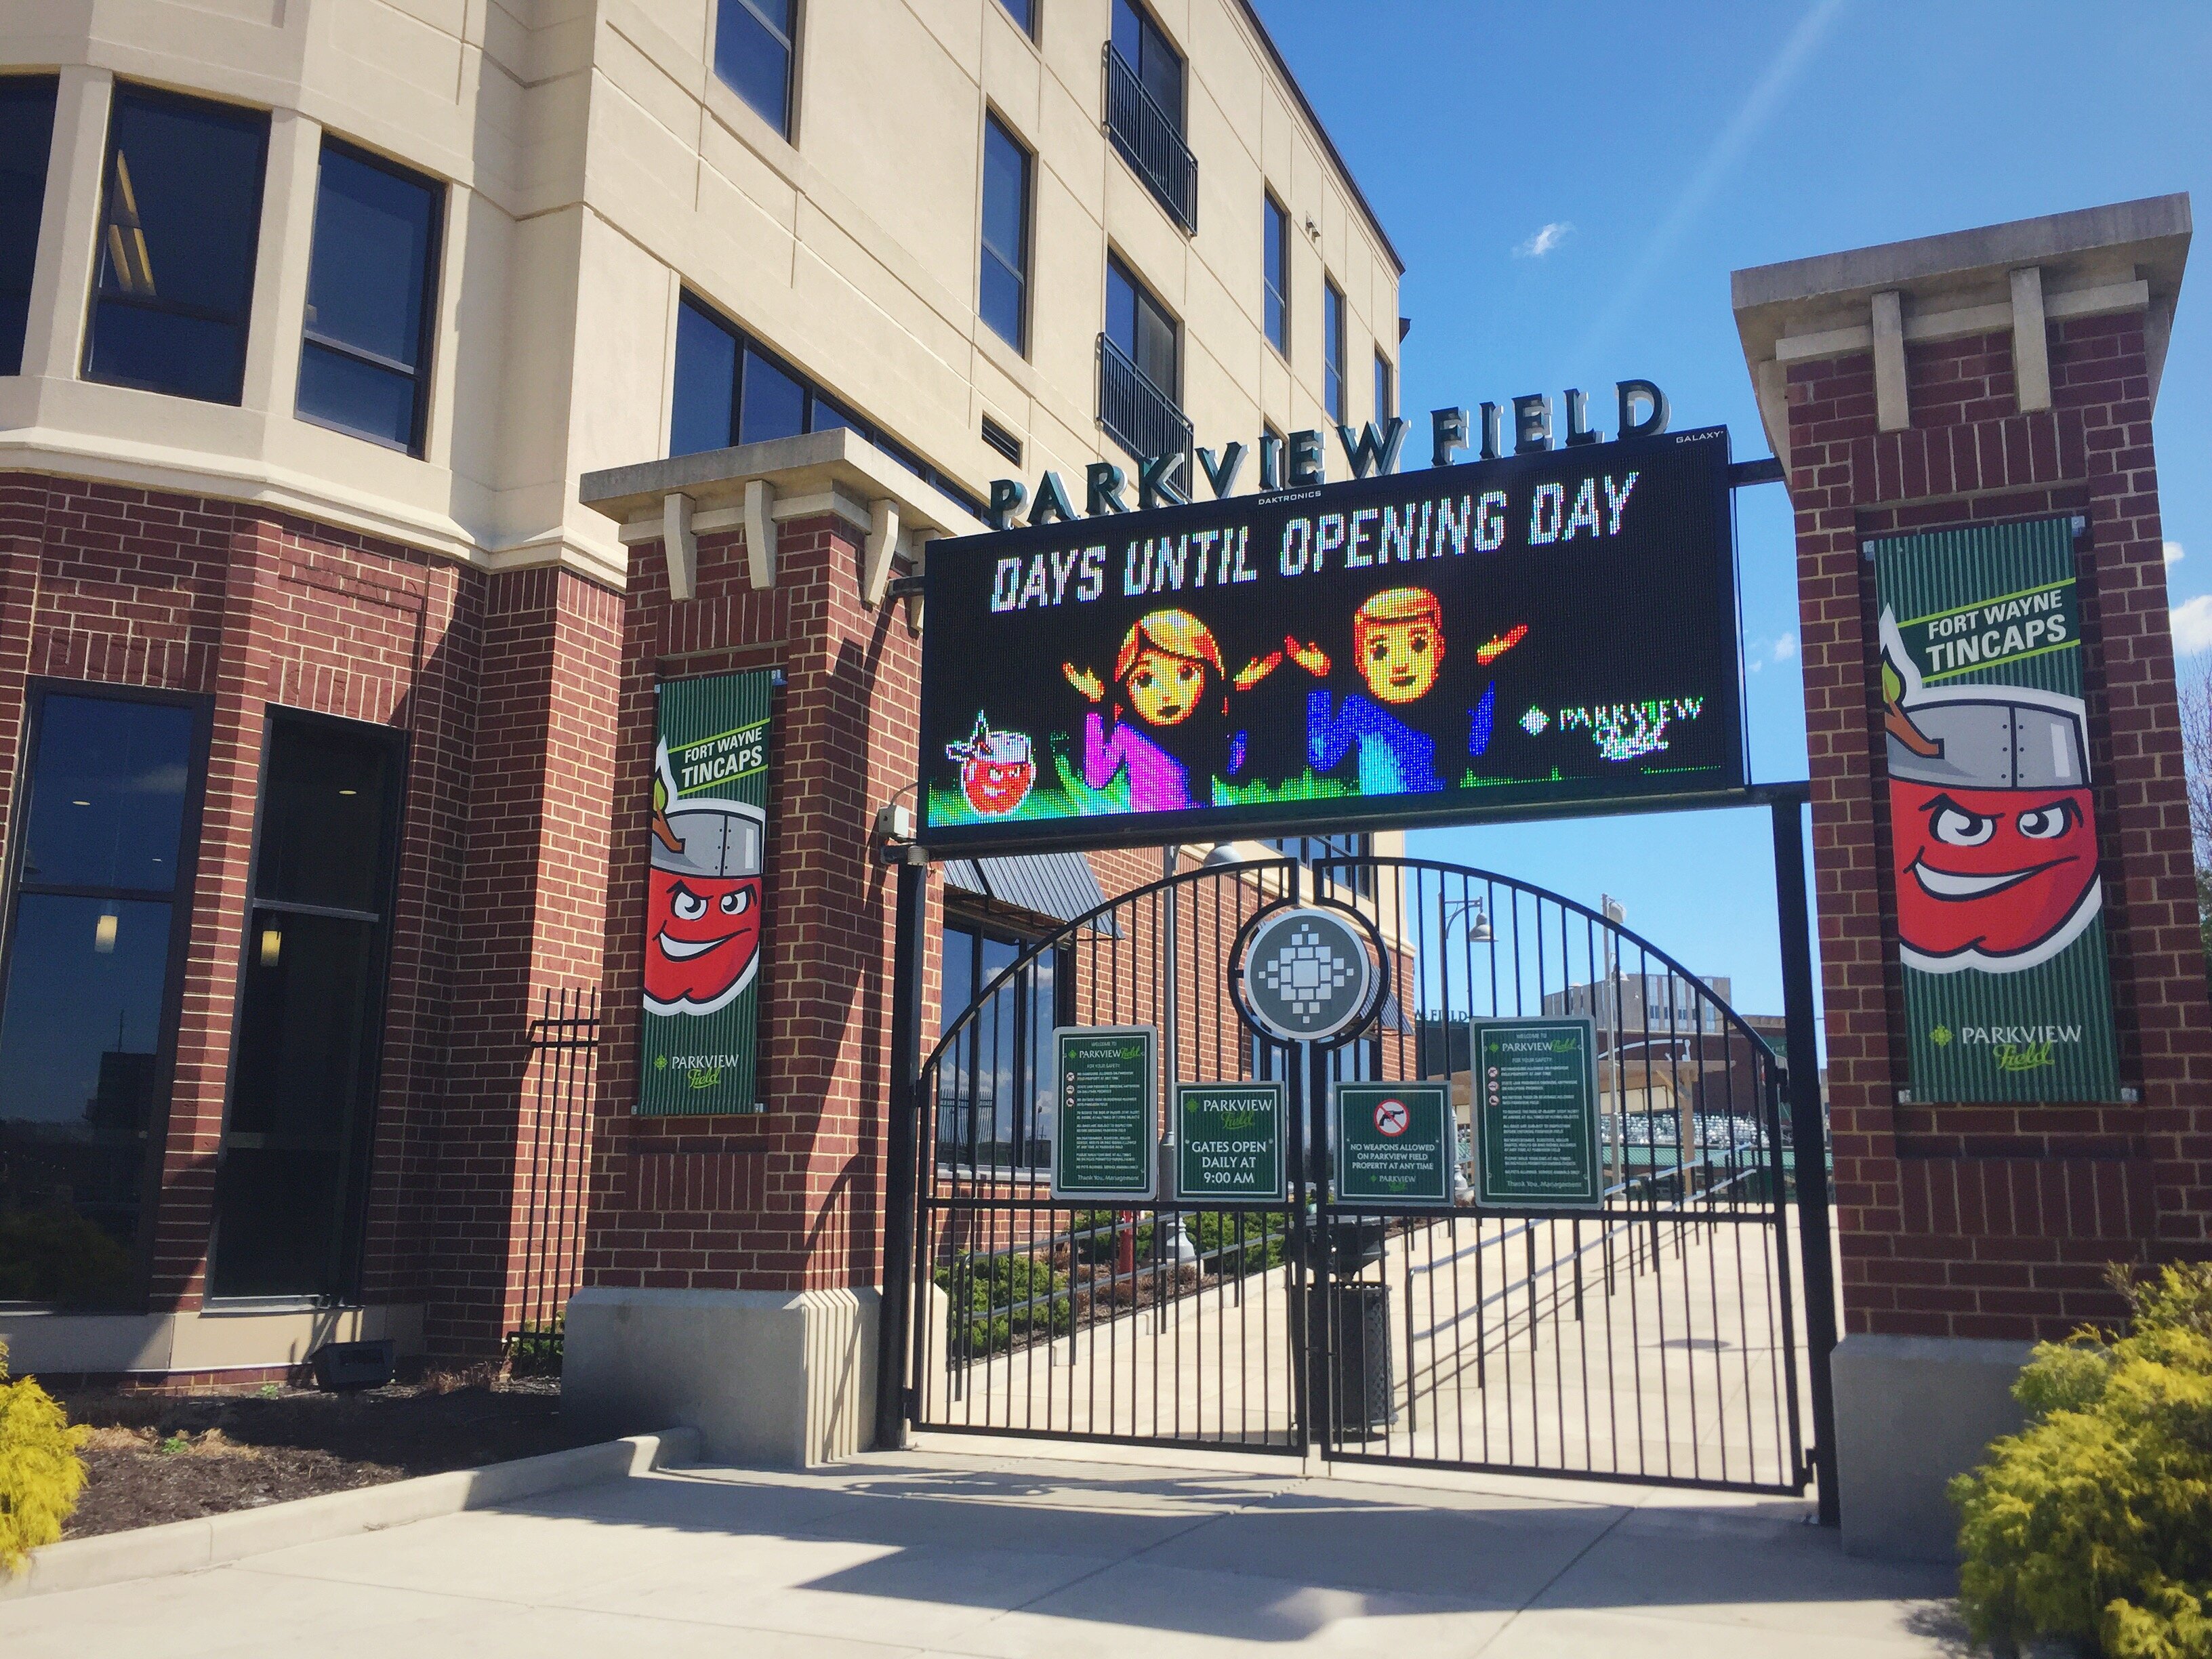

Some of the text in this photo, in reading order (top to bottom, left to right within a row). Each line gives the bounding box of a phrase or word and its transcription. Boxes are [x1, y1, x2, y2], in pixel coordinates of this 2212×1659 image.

[990, 379, 1671, 531] PARKVIEW FIELD
[1258, 491, 1322, 505] DAKTRONICS
[991, 472, 1640, 613] DAYS UNTIL OPENING DAY
[1928, 590, 2062, 640] FORT WAYNE
[1926, 614, 2067, 672] TINCAPS
[684, 726, 762, 763] FORT WAYNE
[682, 745, 762, 787] TINCAPS
[1431, 1009, 1467, 1021] FILD
[1963, 1025, 2082, 1044] PARKVIEW
[1080, 1049, 1121, 1058] PARKVIEW
[1502, 1042, 1553, 1051] PARKVIEW
[672, 1054, 739, 1069] PARKVIEW
[1993, 1040, 2055, 1071] Field
[687, 1065, 721, 1088] Field
[1204, 1099, 1272, 1111] PARKVIEW
[1221, 1110, 1256, 1129] Field
[1191, 1141, 1266, 1153] GATES OPEN
[1202, 1157, 1256, 1168] DAILY AT
[1352, 1162, 1388, 1170] PROPERTY
[1204, 1172, 1254, 1183] 9:00 AM
